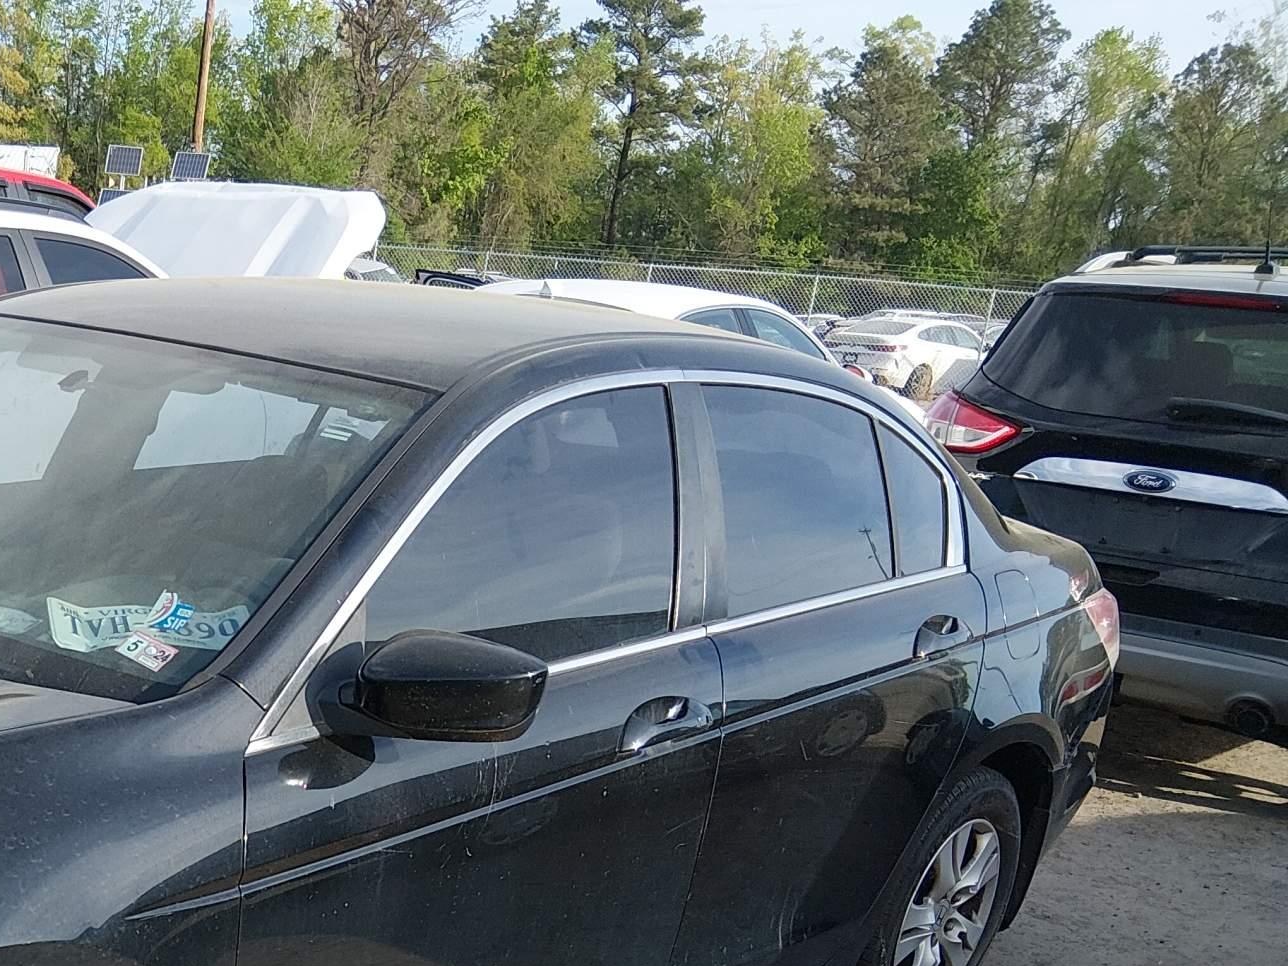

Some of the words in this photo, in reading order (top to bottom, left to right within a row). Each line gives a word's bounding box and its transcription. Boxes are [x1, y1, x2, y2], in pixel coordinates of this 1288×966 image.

[1133, 473, 1162, 488] Ford
[126, 640, 144, 652] 5
[153, 650, 172, 662] 24
